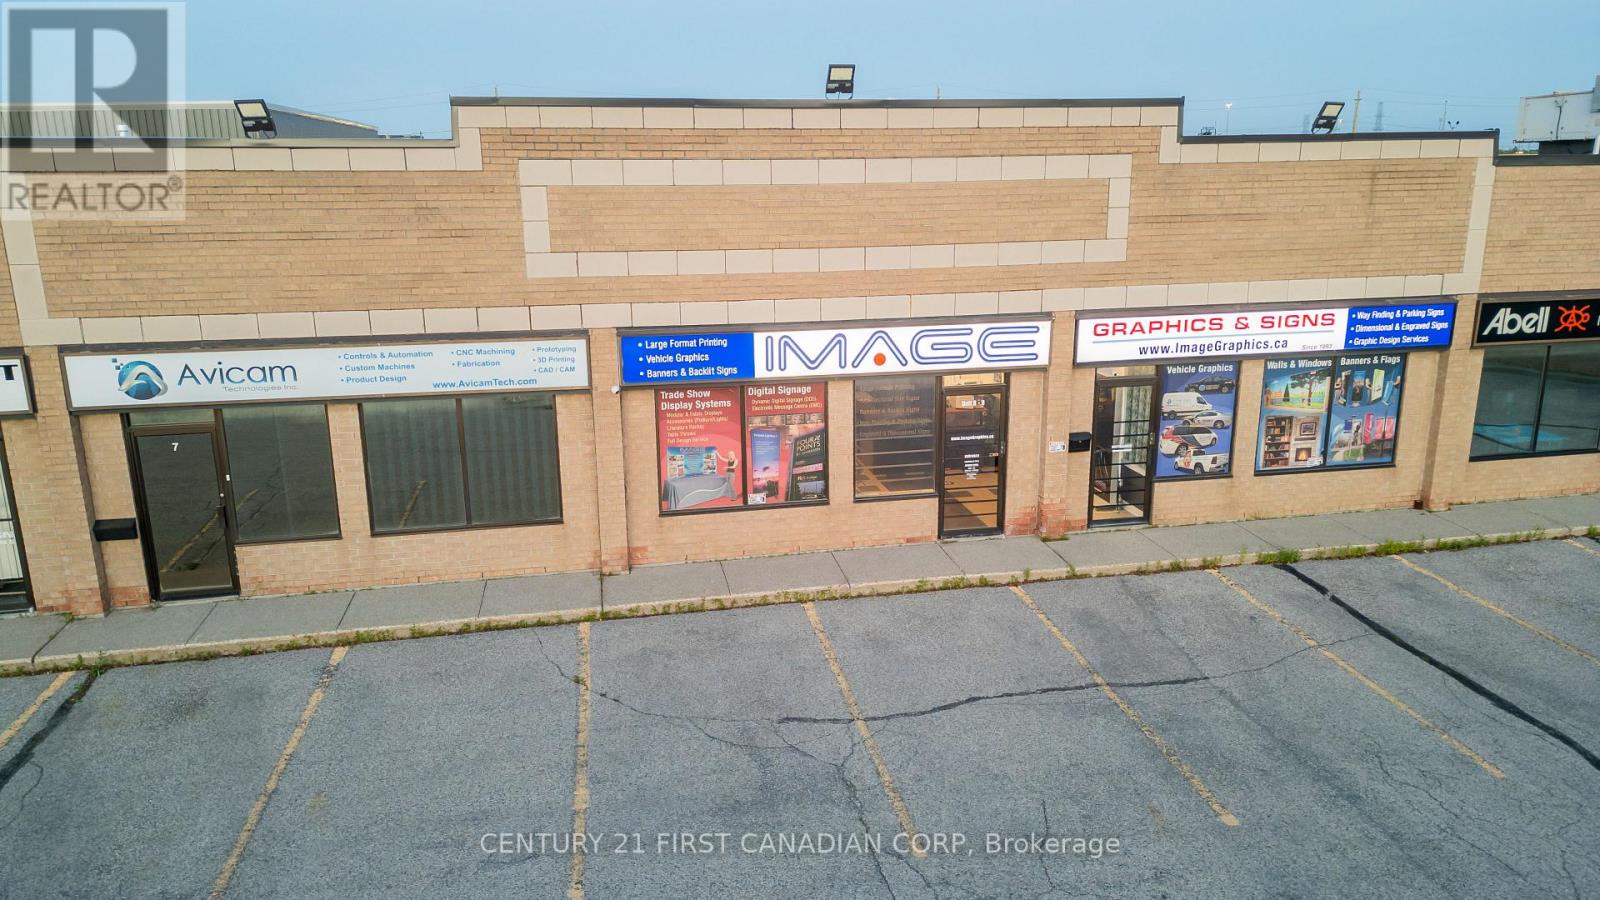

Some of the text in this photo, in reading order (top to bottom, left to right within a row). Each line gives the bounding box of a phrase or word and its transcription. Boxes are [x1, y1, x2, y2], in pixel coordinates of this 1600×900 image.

[1356, 308, 1444, 320] Way Finding & Parking Signs
[1093, 313, 1336, 337] GRAPHICS & SIGNS
[1482, 306, 1551, 335] Abell
[1355, 324, 1394, 332] Dimensional
[1401, 322, 1430, 331] Engraved
[1431, 321, 1448, 330] Signs
[645, 338, 728, 350] Large Format Printing
[1354, 335, 1429, 346] Graphic Design Services
[476, 348, 516, 356] Machining
[537, 346, 577, 354] Prototyping
[765, 325, 1040, 372] IMAGE
[1138, 339, 1288, 355] www.ImageGraphics.ca
[344, 352, 377, 360] Controls
[388, 350, 433, 358] Automation
[548, 356, 576, 364] Printing
[646, 353, 709, 364] Vehicle Graphics
[1340, 355, 1400, 366] Banners & Flags
[345, 363, 415, 372] Custom Machines
[457, 360, 500, 368] Fabrication
[1167, 364, 1234, 374] Vehicle Graphics
[1267, 358, 1332, 369] Walls & Windows
[177, 361, 298, 387] Avicam
[647, 366, 738, 378] Banners & Backlit Signs
[380, 375, 407, 383] Design
[432, 377, 538, 389] www.AvicamTech.com
[223, 384, 282, 393] Technologies
[660, 389, 710, 399] Trade Show
[748, 385, 812, 397] Digital Signage
[661, 400, 732, 411] Display Systems
[172, 442, 179, 451] 7
